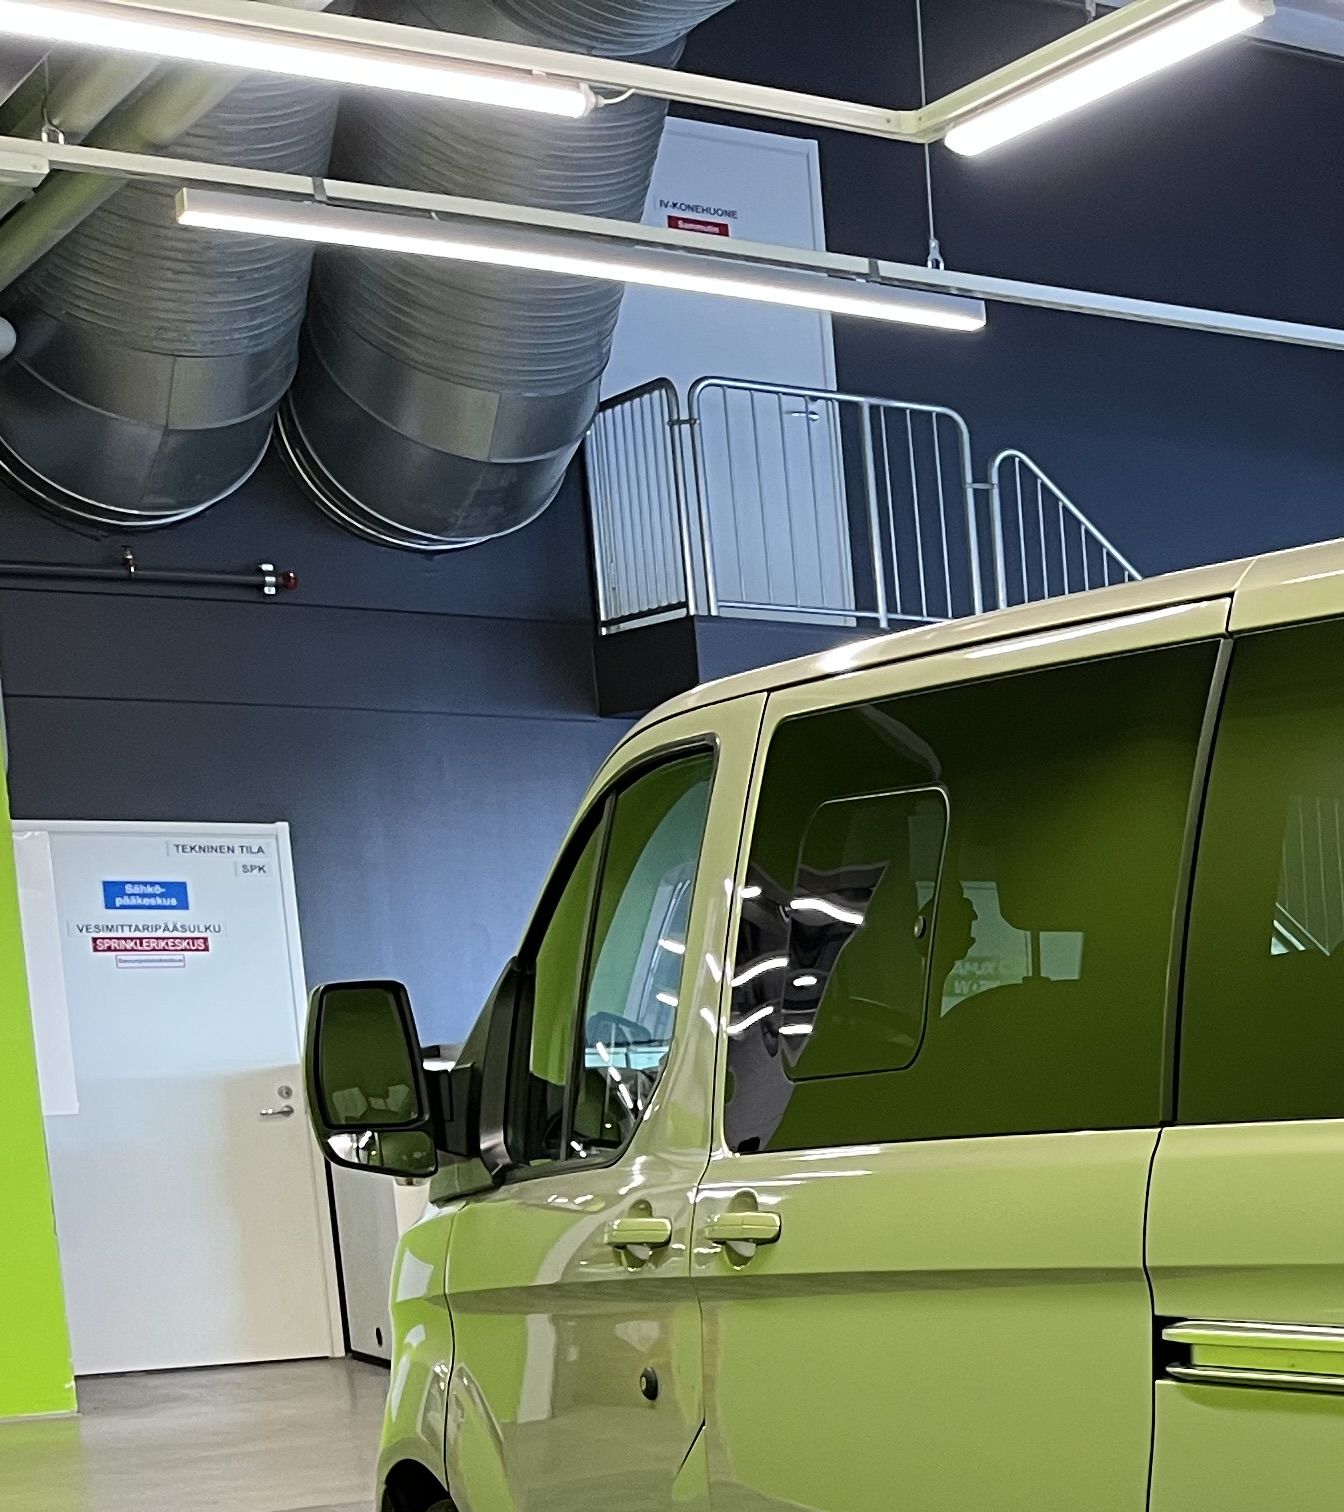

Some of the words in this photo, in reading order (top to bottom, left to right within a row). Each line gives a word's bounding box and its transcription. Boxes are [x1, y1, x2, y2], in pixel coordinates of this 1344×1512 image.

[174, 843, 235, 854] TEKNINEN
[239, 845, 265, 855] TILA
[241, 864, 267, 874] SPK
[124, 883, 166, 894] Sähkö-
[115, 895, 178, 907] pääkeskus
[76, 922, 222, 934] VESIMITTARIPÄÄSULKU
[95, 938, 205, 951] SPRINKLERIKESKUS
